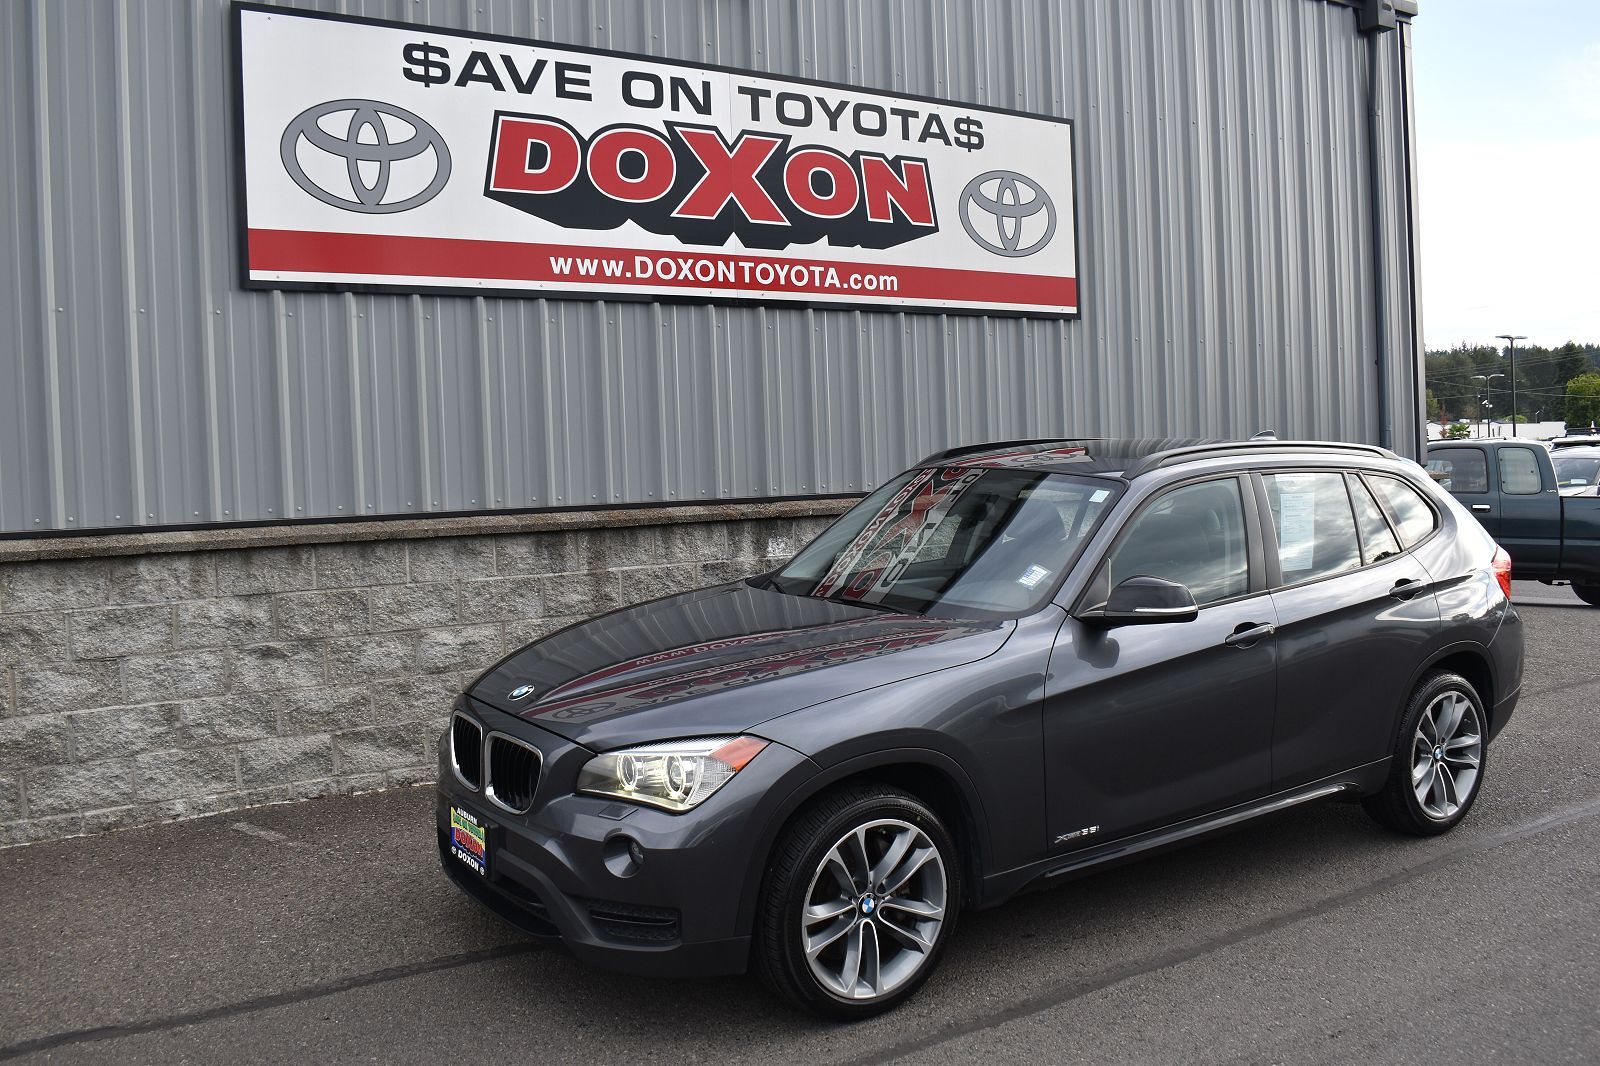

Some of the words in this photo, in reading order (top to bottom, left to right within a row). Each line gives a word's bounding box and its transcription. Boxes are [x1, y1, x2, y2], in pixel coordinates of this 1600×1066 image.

[402, 41, 593, 102] $AVE
[621, 70, 712, 116] ON
[738, 85, 985, 153] TOYOTA$
[486, 110, 938, 236] DOXON
[549, 254, 899, 292] www.DOXONTOYOTA.com
[457, 849, 480, 872] DOXON
